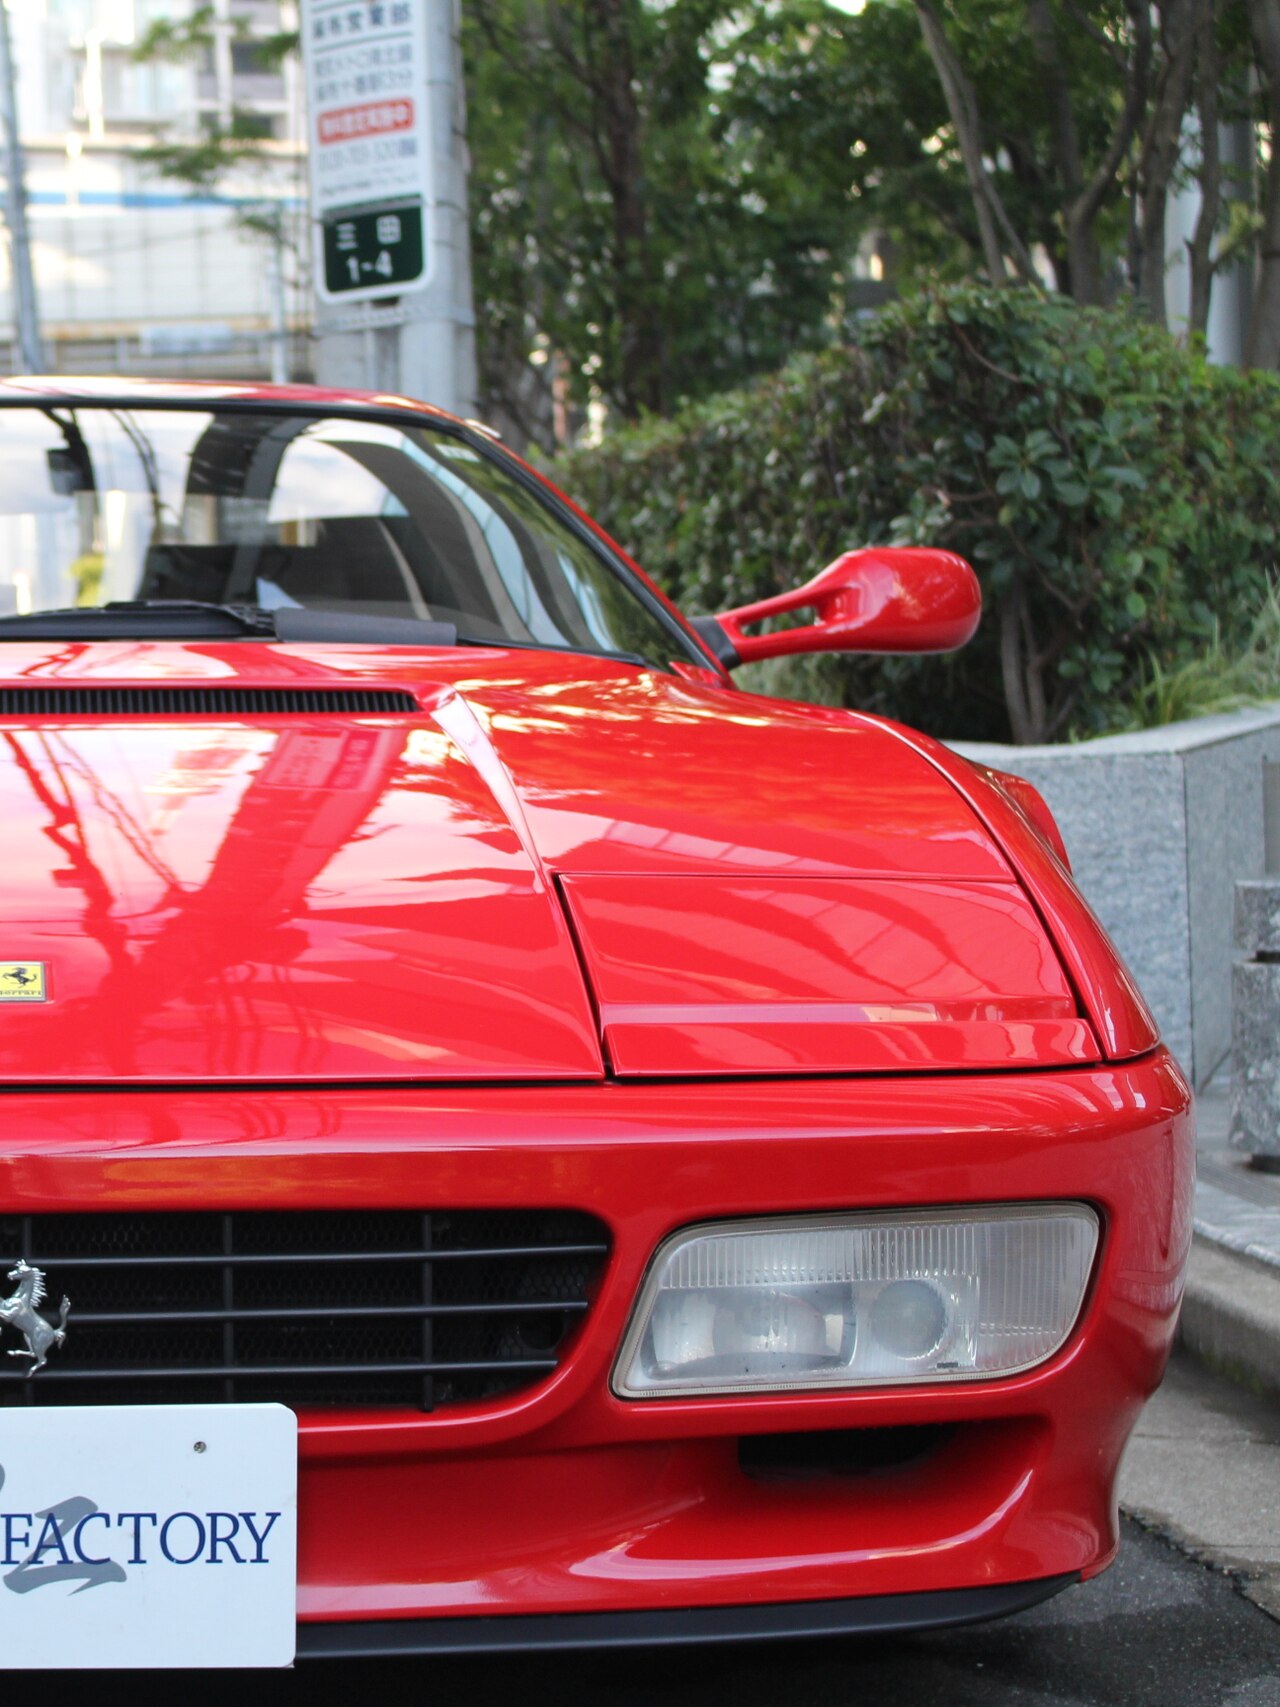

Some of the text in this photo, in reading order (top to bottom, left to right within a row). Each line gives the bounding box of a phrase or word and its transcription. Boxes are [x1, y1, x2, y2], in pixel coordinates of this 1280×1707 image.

[336, 214, 401, 251] 三田
[345, 250, 393, 283] 1-4
[0, 1511, 282, 1566] FACTORY
